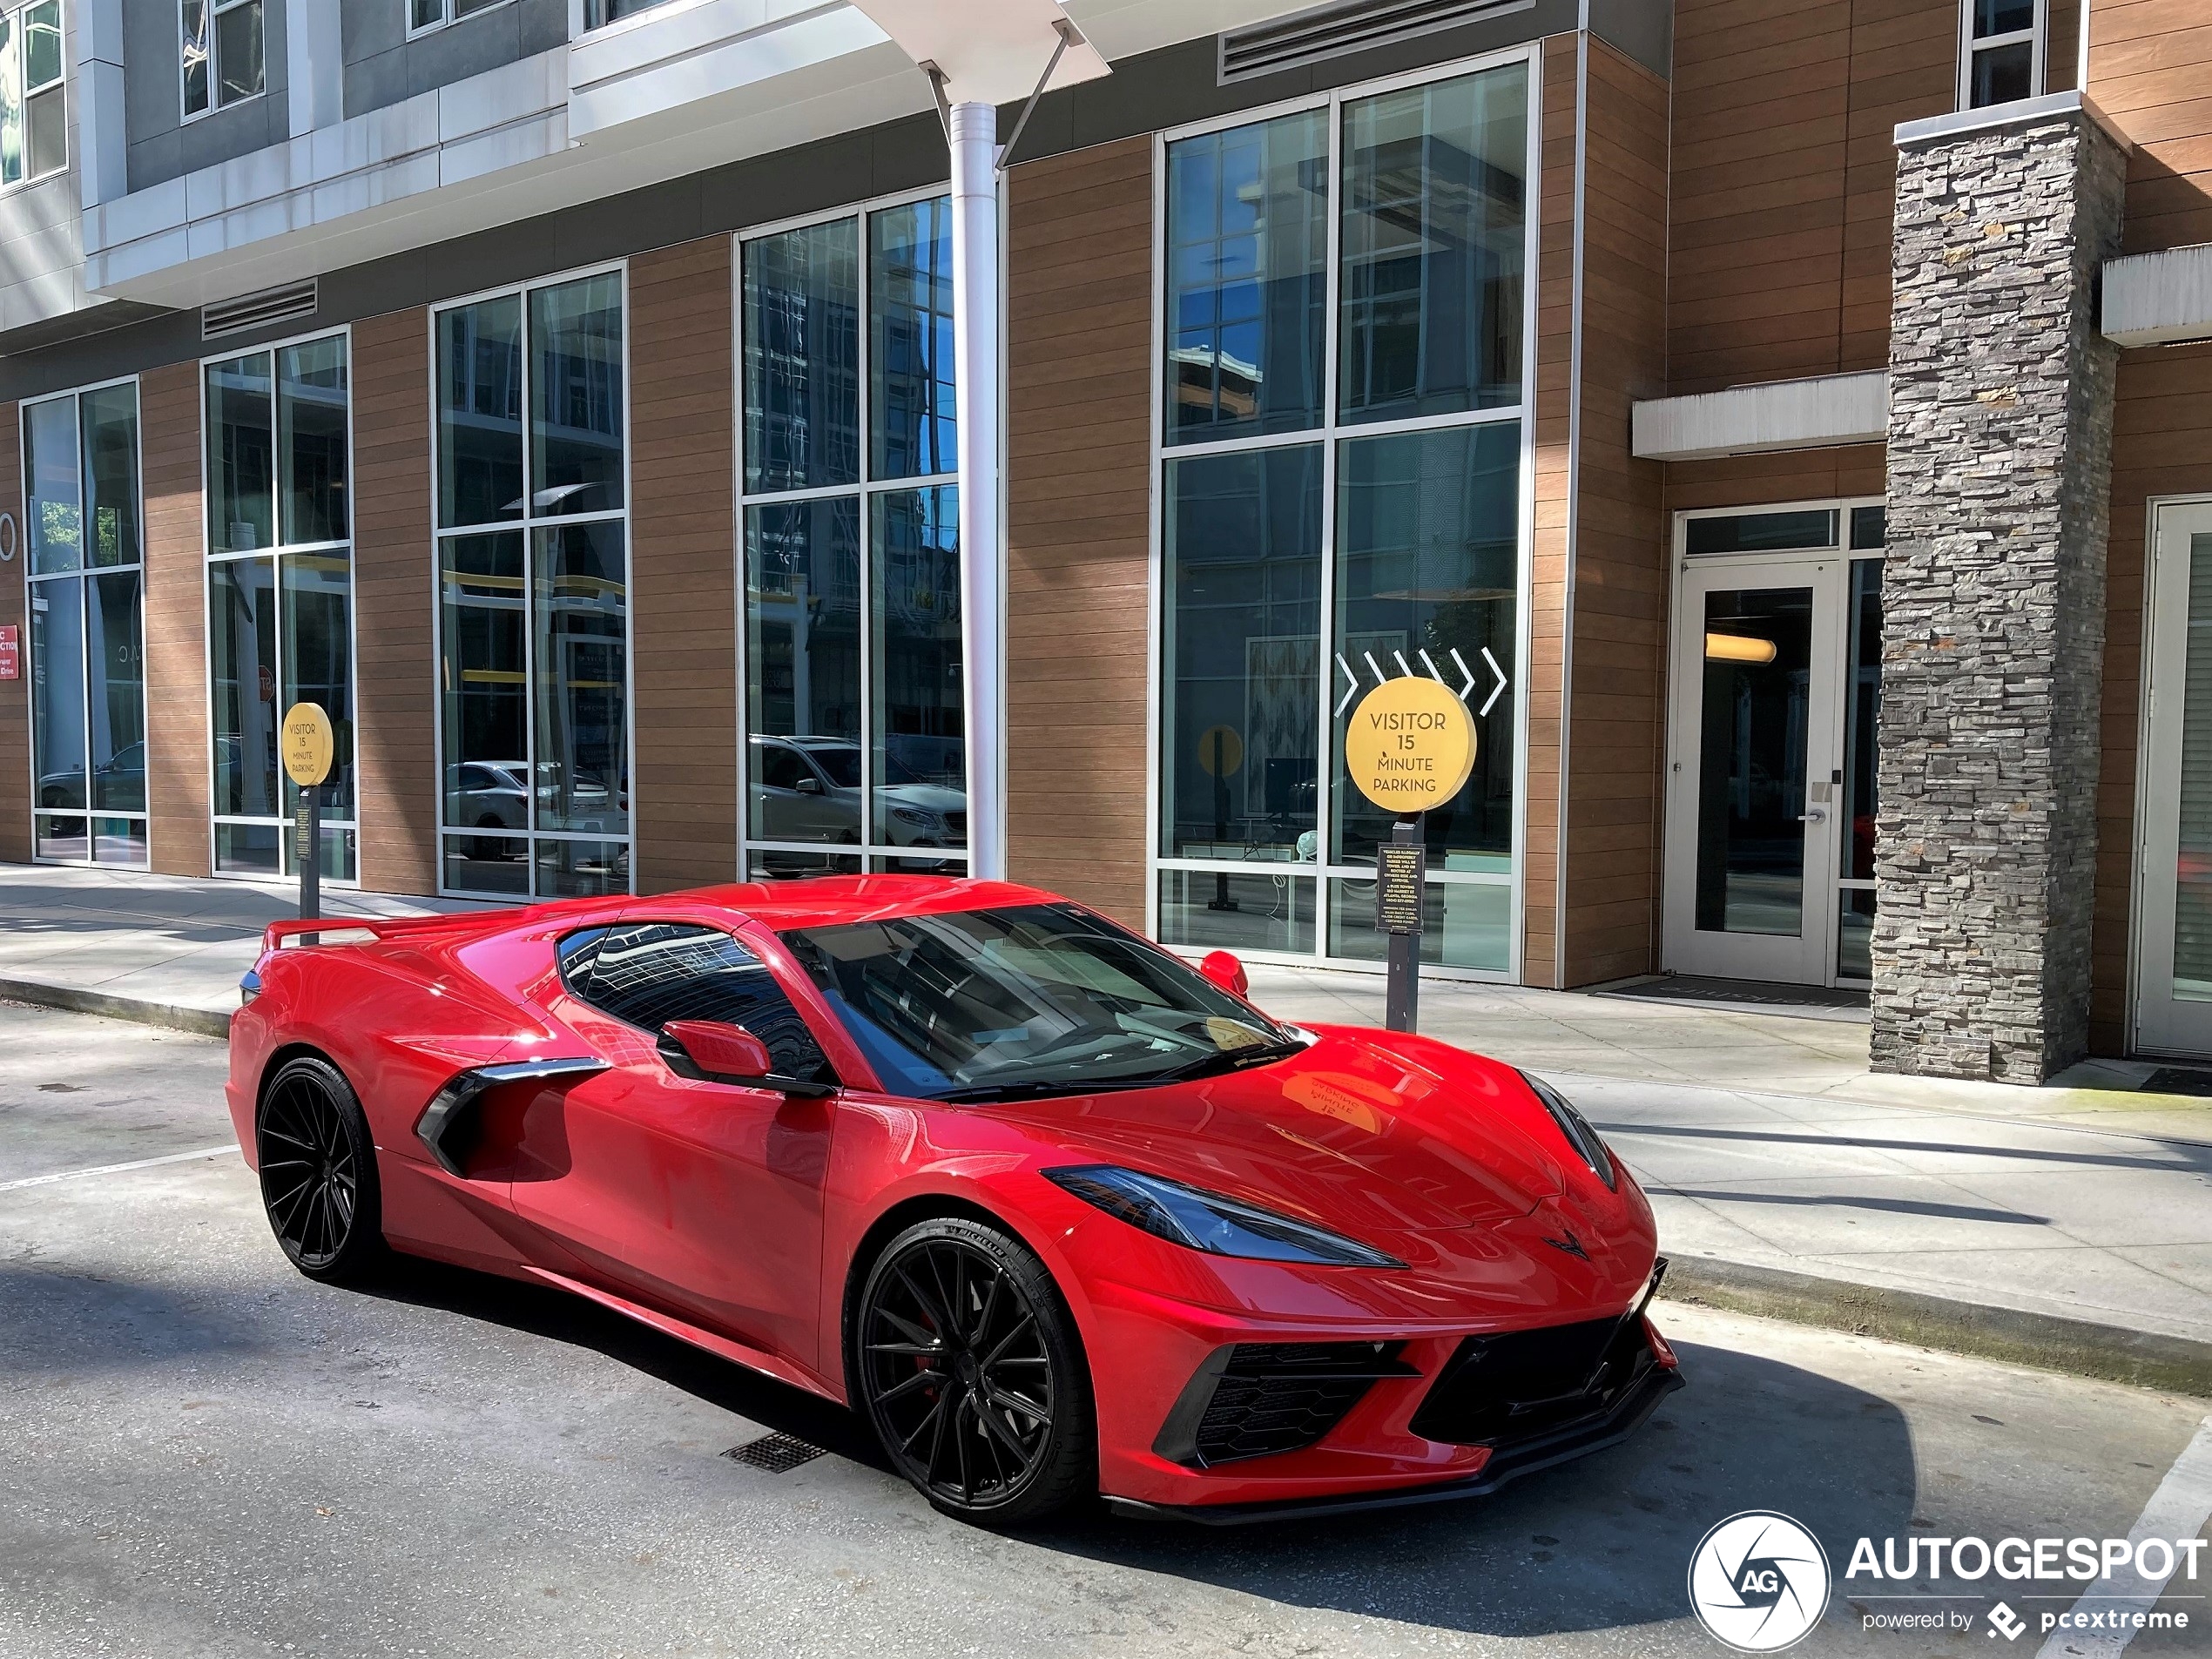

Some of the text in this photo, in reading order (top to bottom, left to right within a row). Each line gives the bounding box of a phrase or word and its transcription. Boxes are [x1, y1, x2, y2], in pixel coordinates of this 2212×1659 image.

[1370, 712, 1446, 730] VISITOR
[288, 724, 315, 734] VISITOR
[299, 737, 306, 746] 15
[1398, 735, 1415, 750] 15
[293, 751, 313, 759] MINUTE
[292, 764, 314, 772] PARKING
[1378, 758, 1433, 771] MINUTE
[1373, 778, 1436, 792] PARKING
[960, 1228, 1004, 1257] MICHELIN
